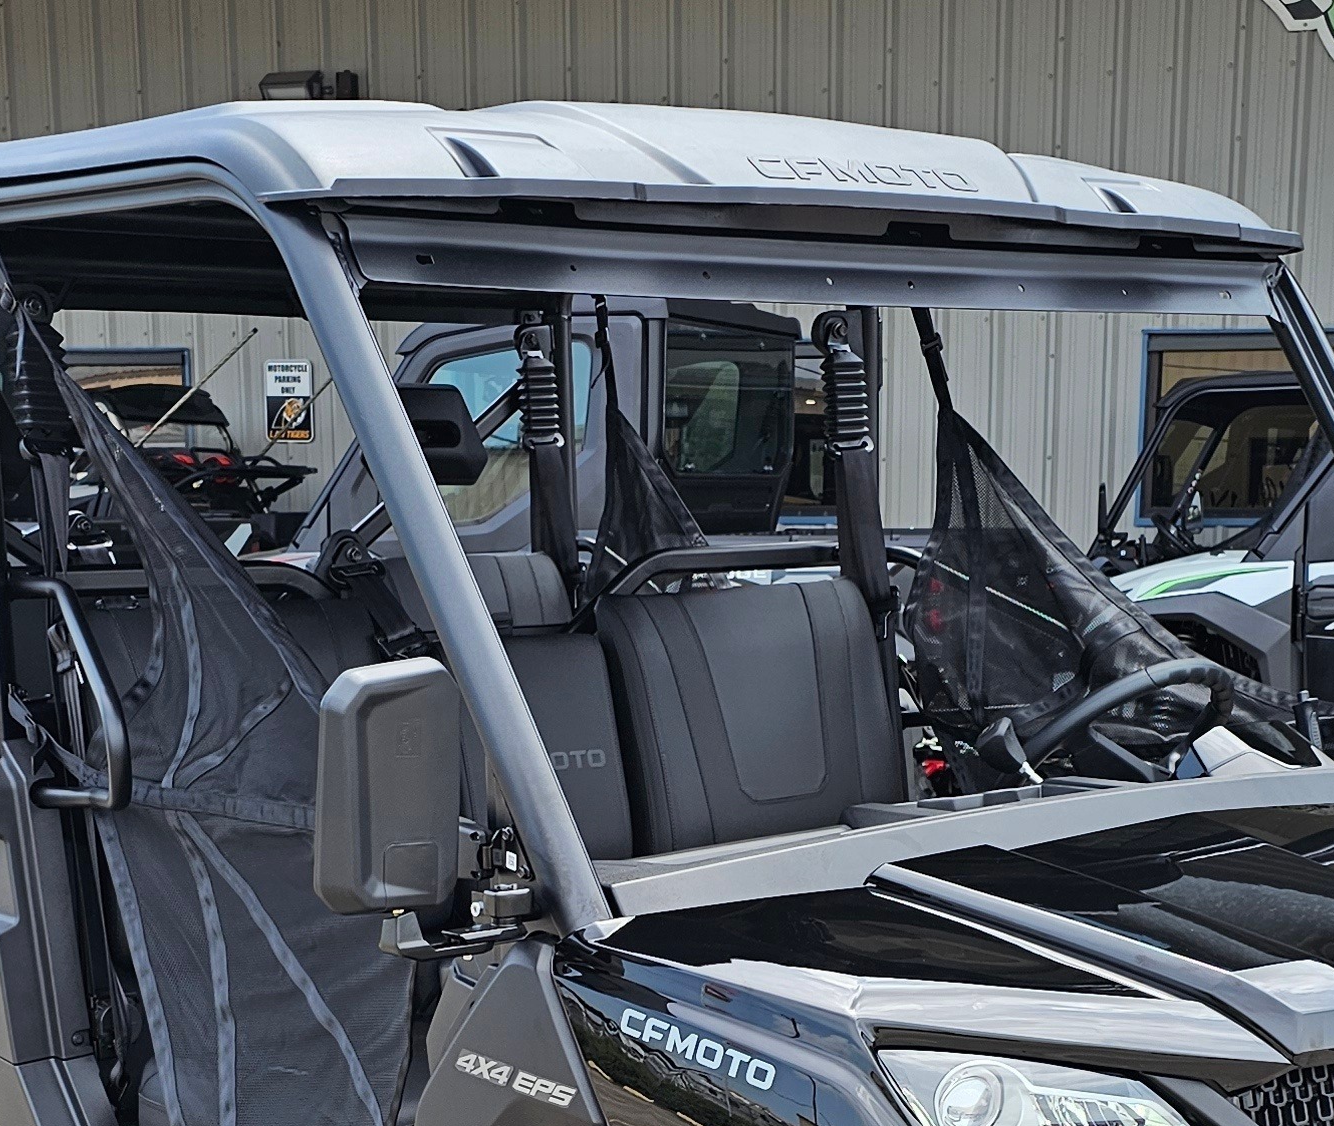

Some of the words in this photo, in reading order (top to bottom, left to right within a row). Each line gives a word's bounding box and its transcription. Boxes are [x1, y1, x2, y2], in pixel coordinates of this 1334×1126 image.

[747, 156, 979, 192] CFMOTO
[268, 364, 307, 372] MOTORCYCLE
[274, 375, 301, 383] PARKING
[281, 386, 295, 394] ONLY
[550, 749, 606, 771] OTO
[620, 1008, 776, 1091] CFMOTO
[456, 1053, 511, 1086] 4X4
[512, 1071, 578, 1107] EPS
